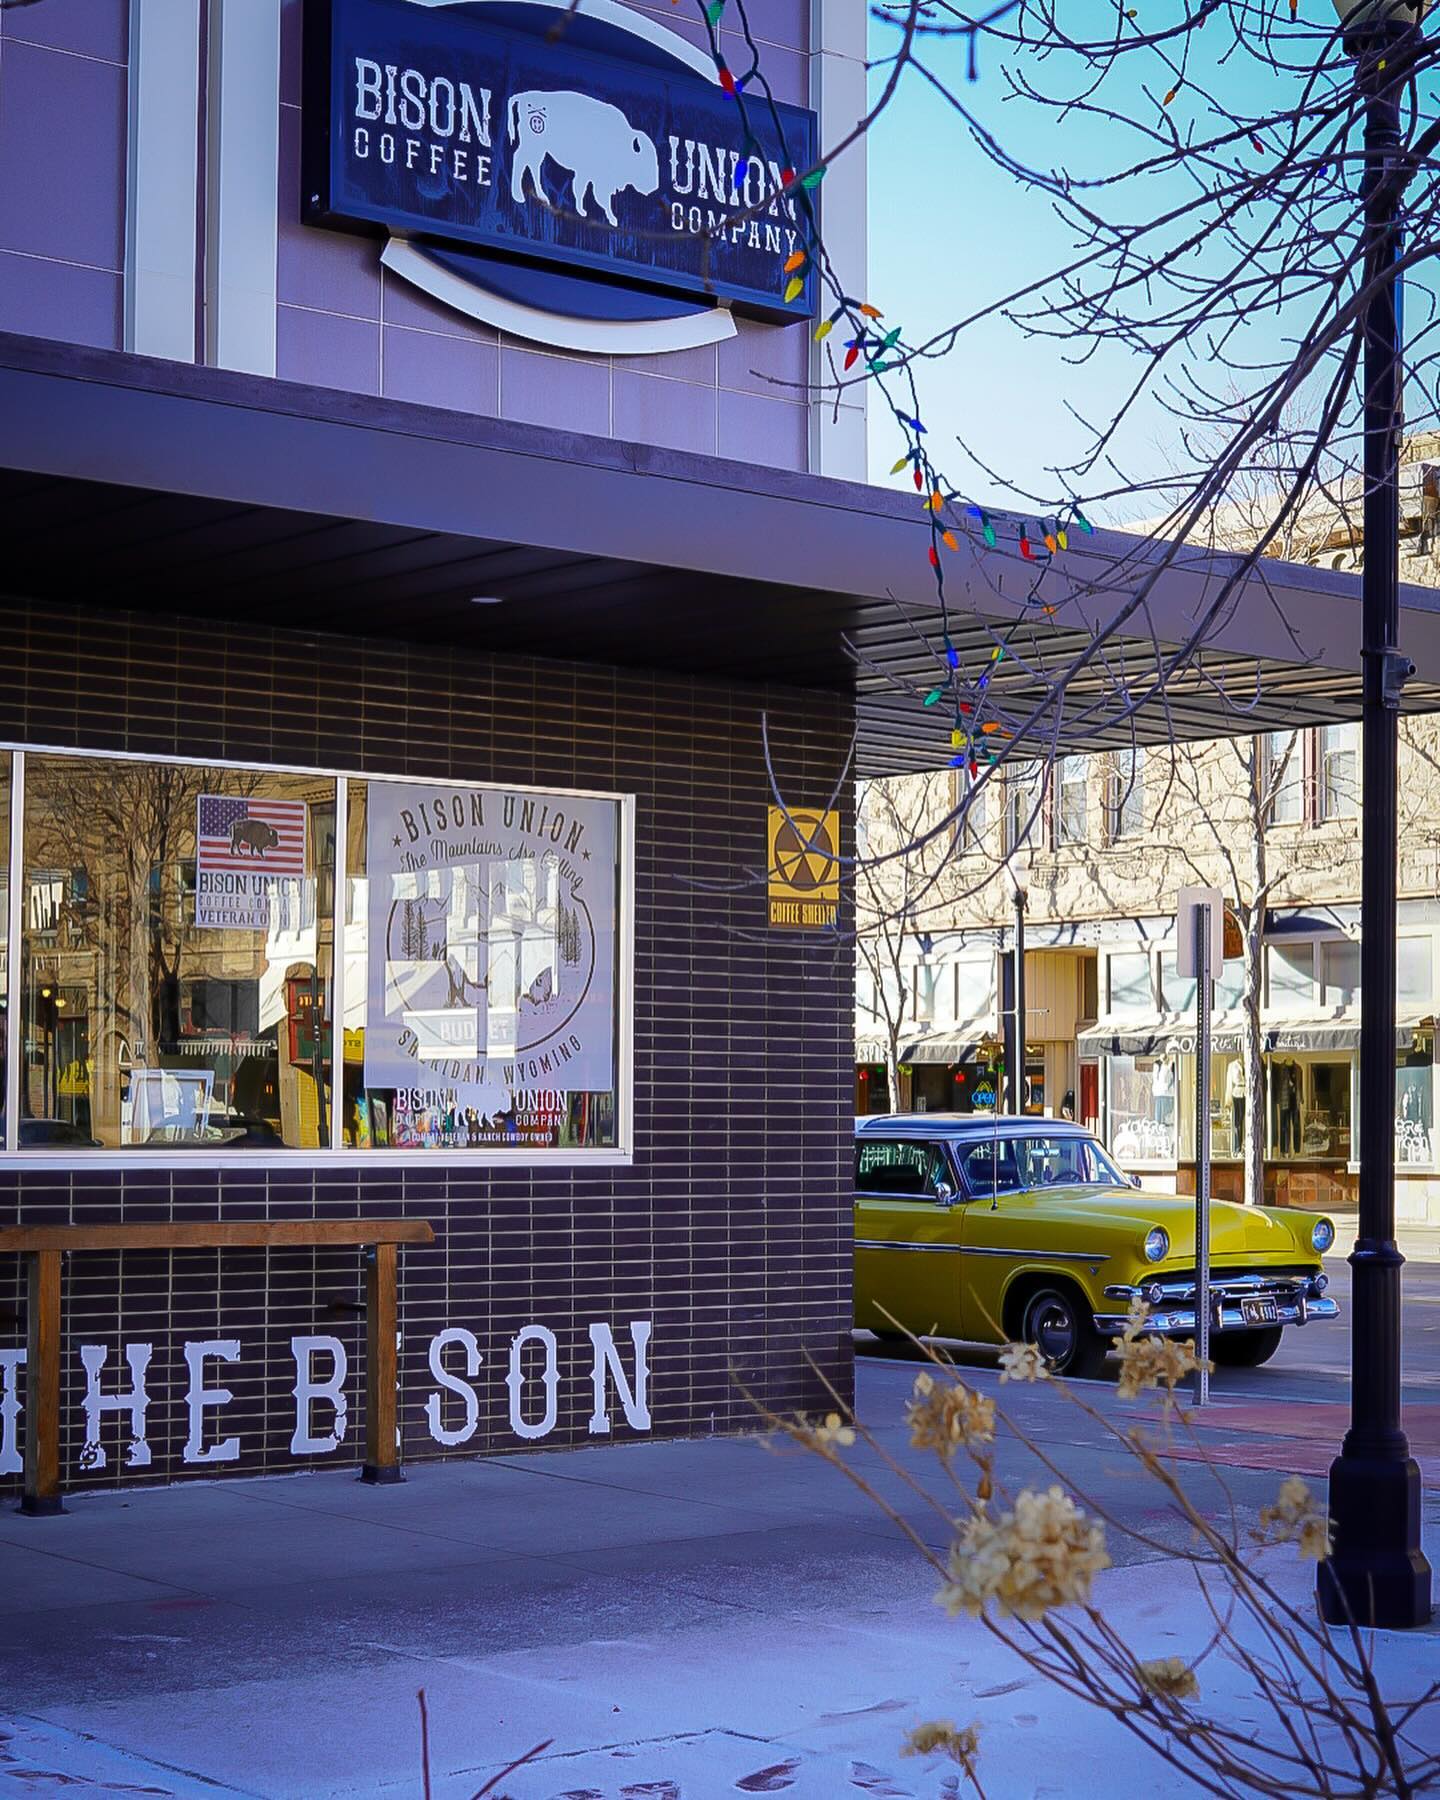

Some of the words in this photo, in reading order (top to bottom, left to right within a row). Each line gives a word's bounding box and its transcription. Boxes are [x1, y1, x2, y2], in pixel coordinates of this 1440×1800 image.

[354, 57, 492, 148] BISON
[668, 135, 797, 221] UNION
[354, 127, 492, 187] COFFEE
[671, 202, 797, 256] COMPANY
[400, 793, 485, 843] BISON
[503, 795, 585, 854] UNION
[401, 851, 427, 873] The
[431, 837, 503, 864] Mountains
[200, 872, 247, 895] BISON
[200, 895, 241, 908] COFFEE
[770, 901, 800, 924] COFFEE
[802, 904, 838, 926] SHELTER
[200, 909, 255, 925] VETERAN
[440, 1017, 509, 1041] BUDET
[503, 1034, 582, 1085] WYOMING
[396, 1088, 447, 1112] BISON
[515, 1089, 568, 1112] UNION
[971, 1091, 996, 1105] OPEN
[515, 1114, 568, 1127] COMPANY
[291, 1321, 652, 1456] BSON
